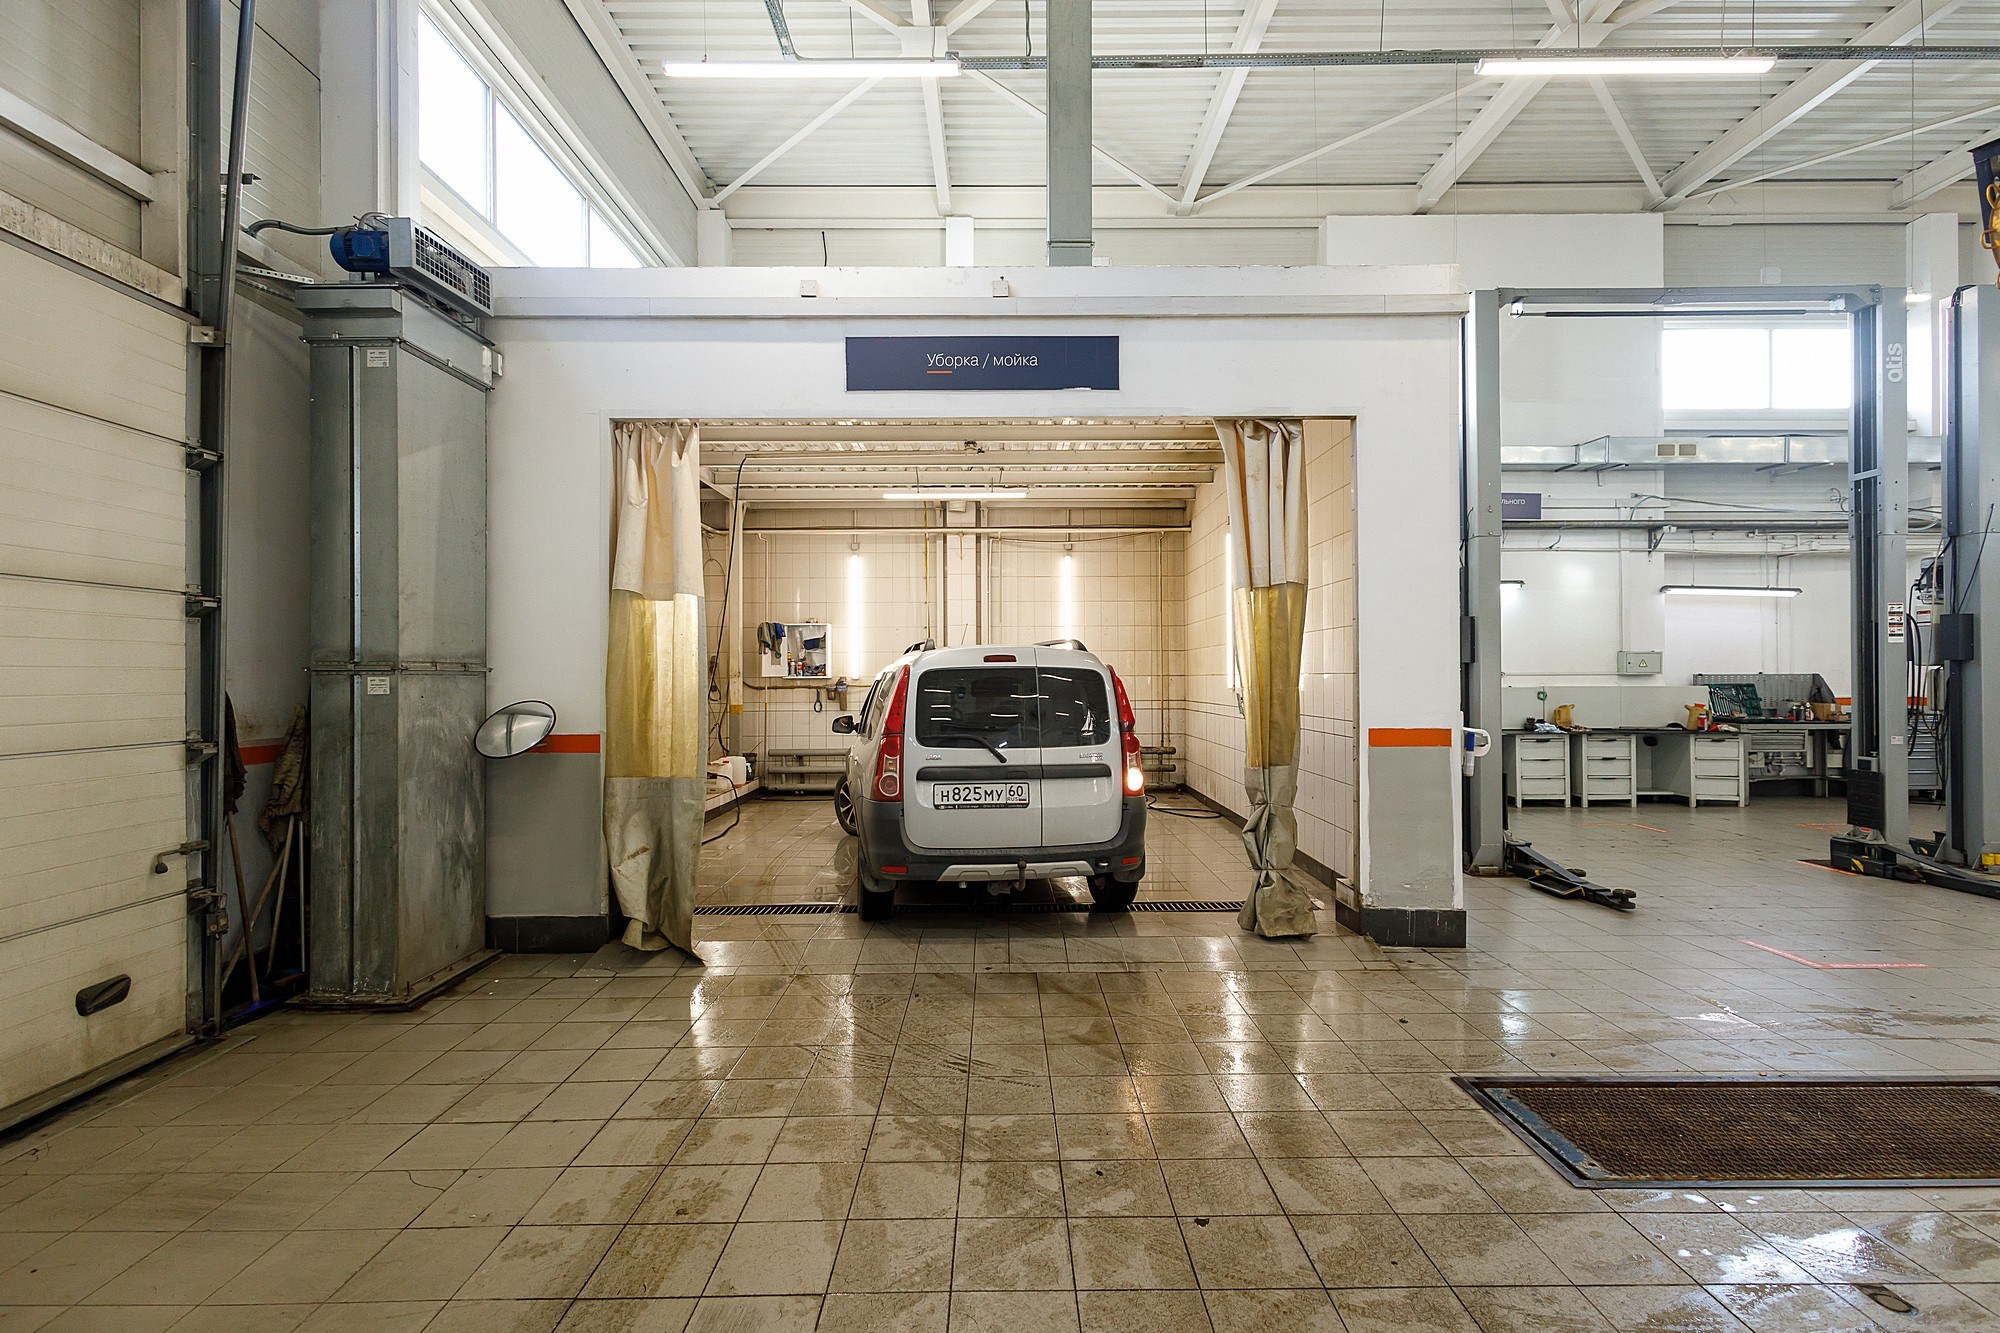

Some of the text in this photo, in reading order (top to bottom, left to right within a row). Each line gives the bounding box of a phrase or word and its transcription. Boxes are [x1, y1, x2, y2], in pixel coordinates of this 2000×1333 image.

[927, 353, 1038, 369] Уборка / мойка
[941, 785, 1024, 802] Н825МУ 60
